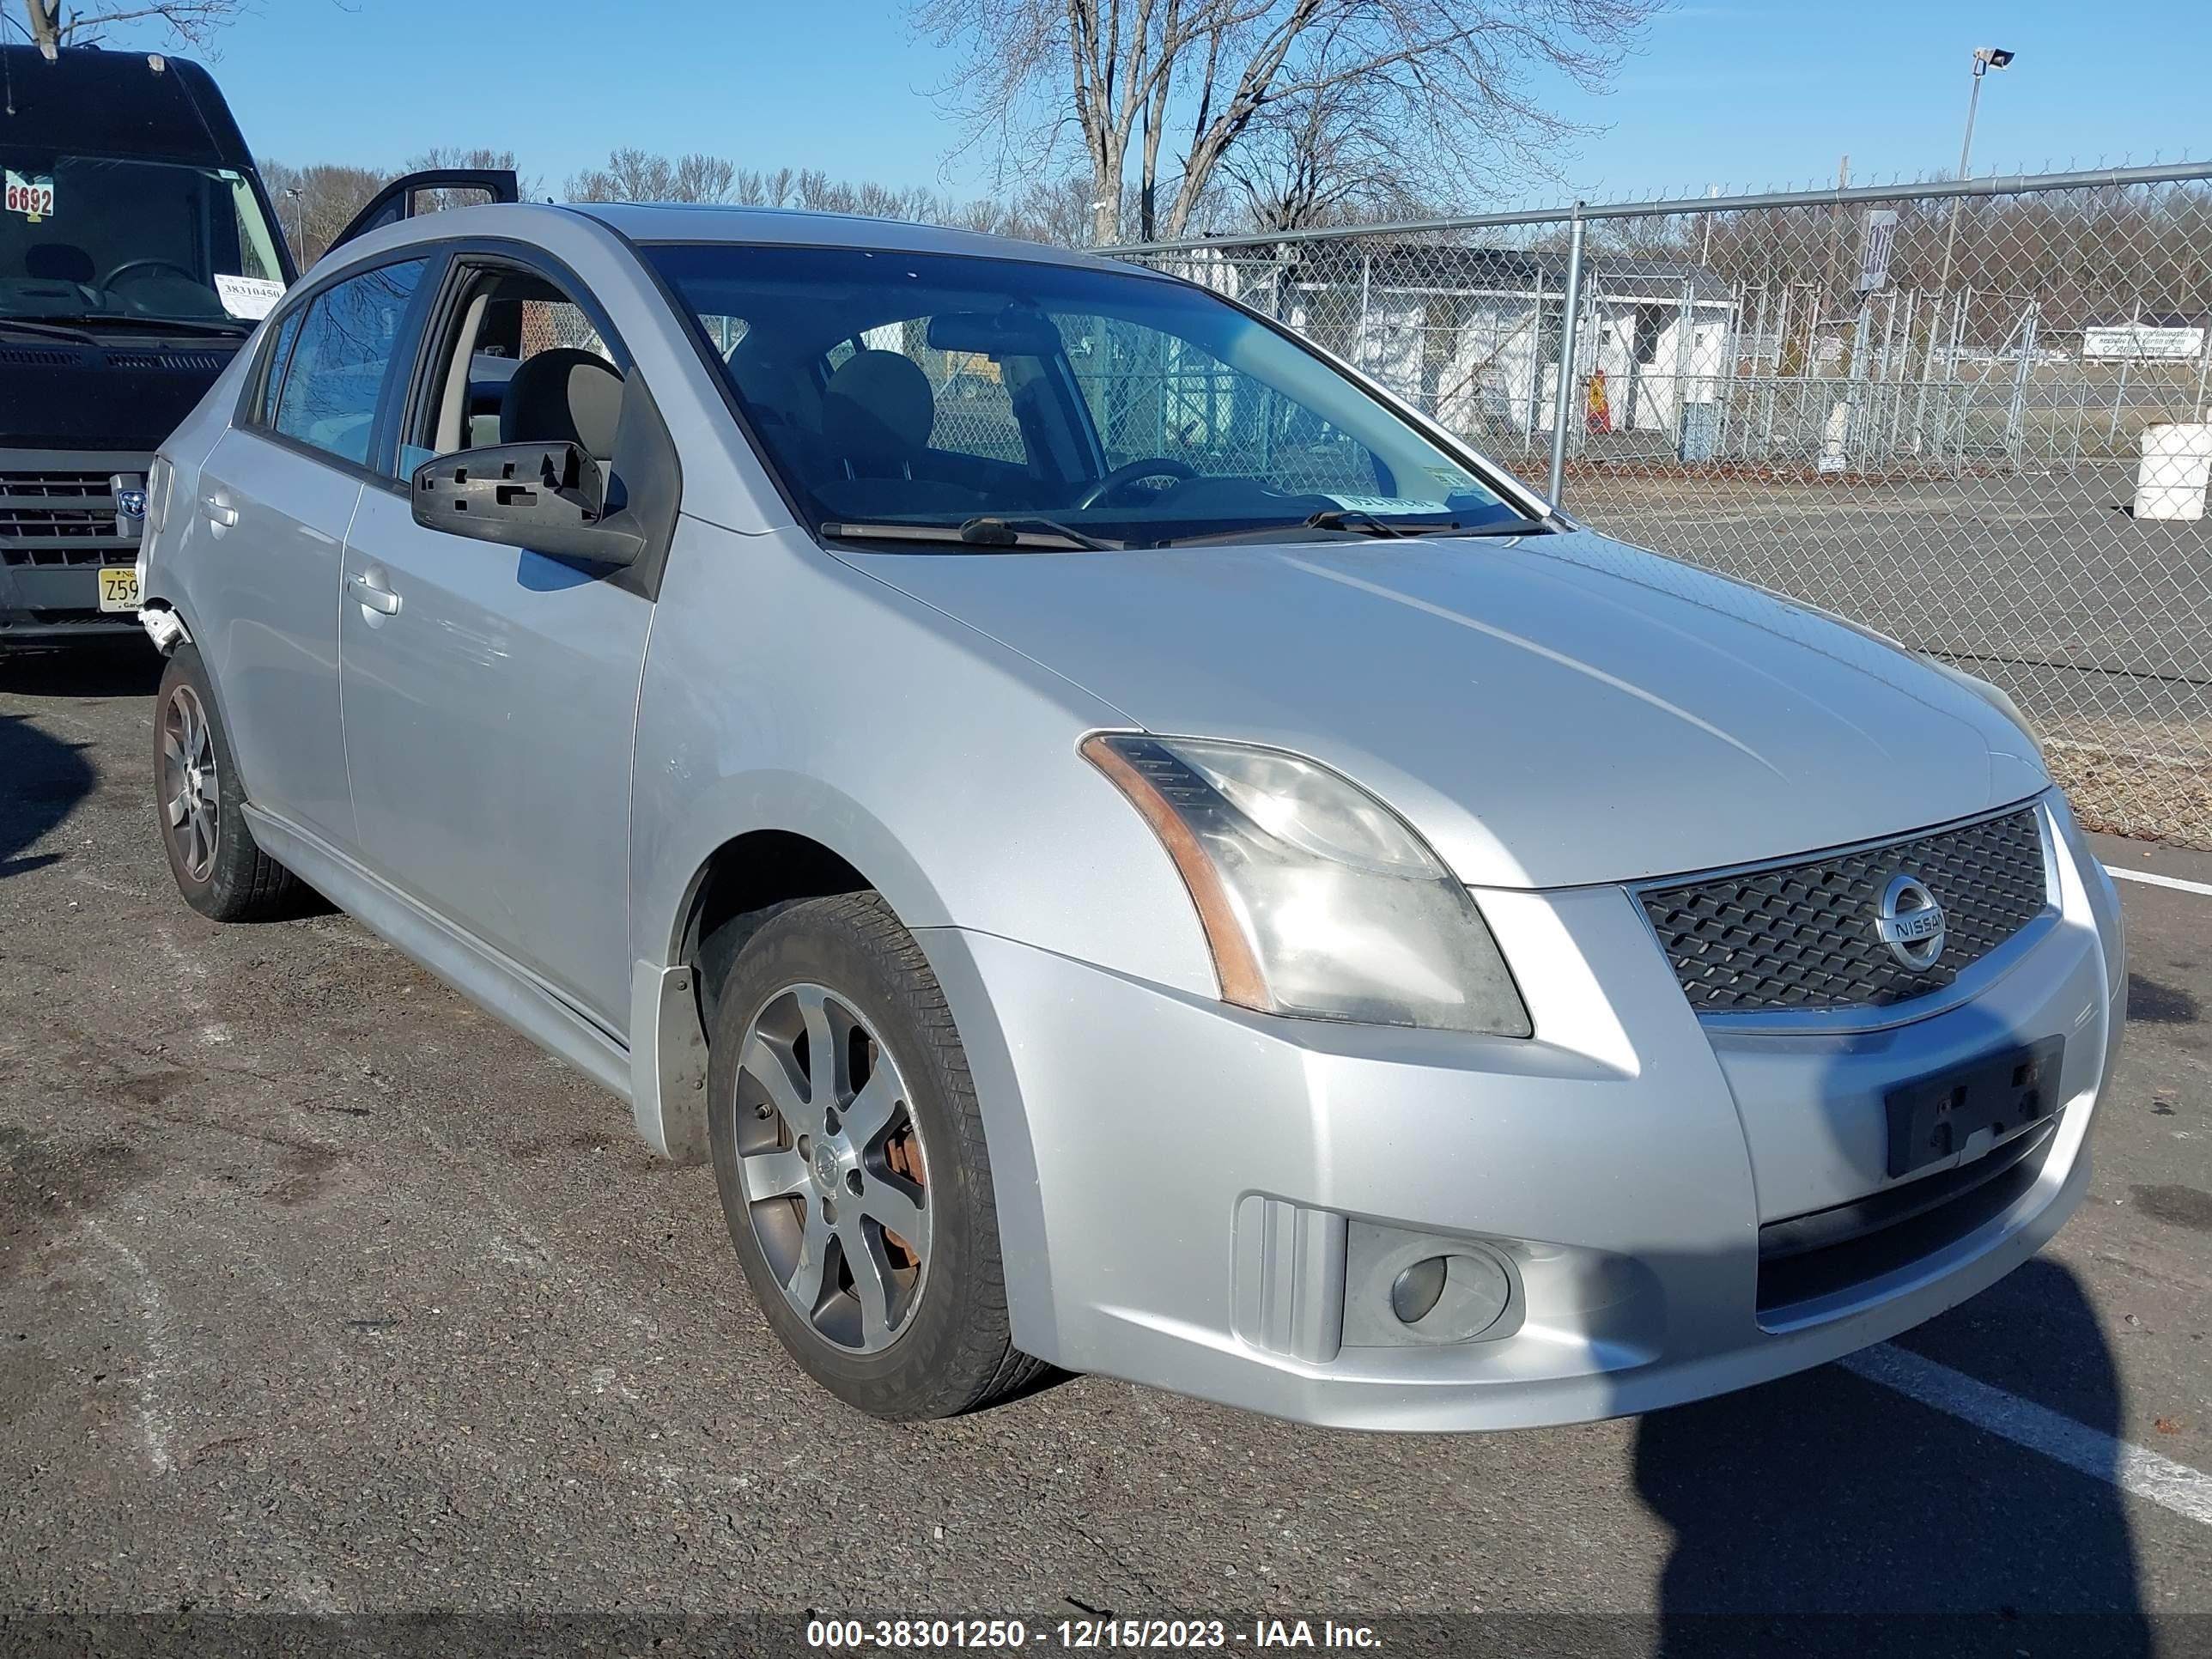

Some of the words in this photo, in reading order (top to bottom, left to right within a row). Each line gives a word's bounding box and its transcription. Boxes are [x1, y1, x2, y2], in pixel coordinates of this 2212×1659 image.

[8, 185, 52, 215] 6692
[224, 284, 280, 298] 38310450
[106, 580, 138, 600] Z59
[1895, 913, 1943, 938] NISSAN
